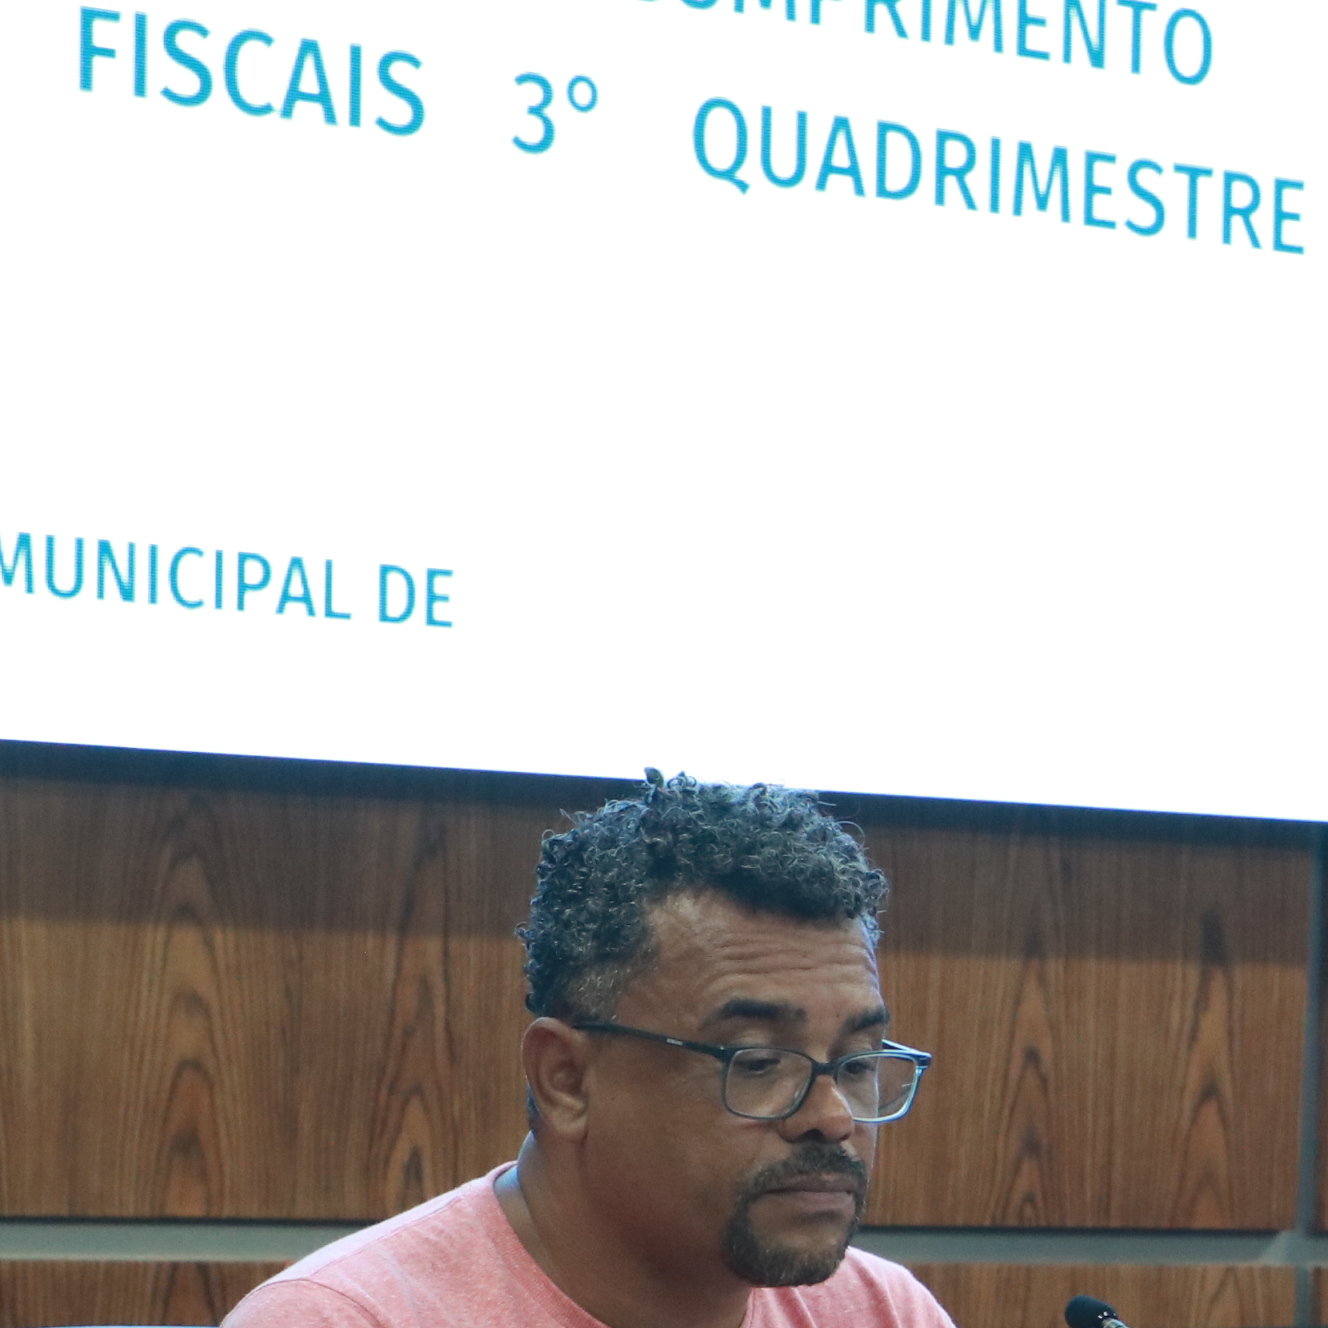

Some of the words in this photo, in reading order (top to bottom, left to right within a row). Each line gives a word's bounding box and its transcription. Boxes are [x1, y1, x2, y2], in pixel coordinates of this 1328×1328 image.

[644, 0, 1212, 85] IMENTO
[80, 6, 425, 136] FISCAIS
[693, 97, 1304, 254] QUADRIMESTRE
[0, 532, 351, 620] MUNICIPAL
[379, 564, 453, 628] DE
